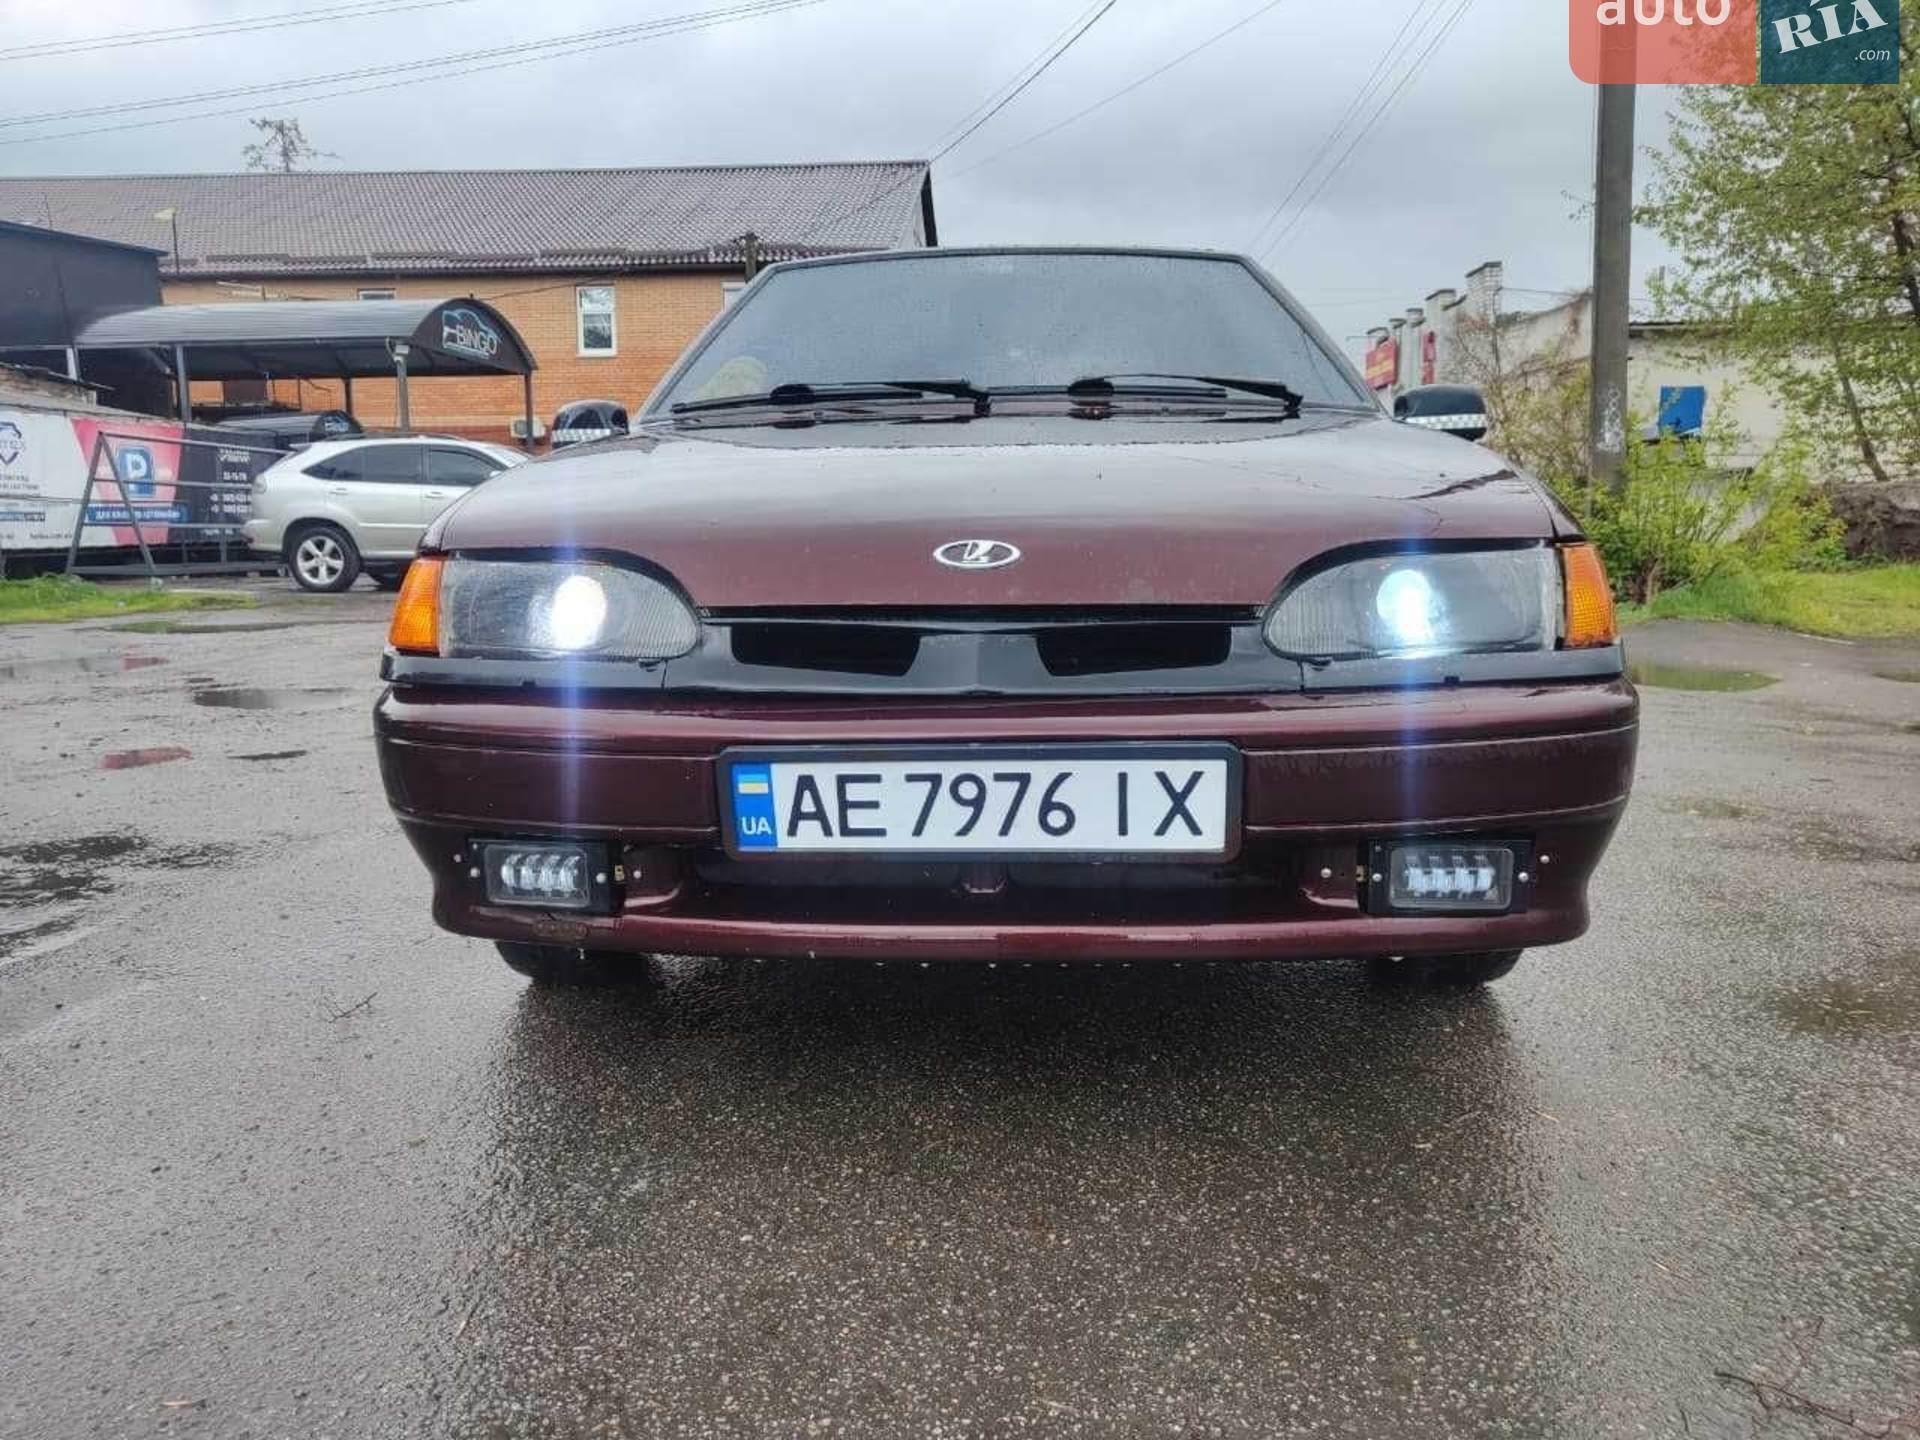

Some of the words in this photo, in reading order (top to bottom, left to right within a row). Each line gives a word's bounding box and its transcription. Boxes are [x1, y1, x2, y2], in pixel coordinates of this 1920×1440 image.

[456, 324, 498, 355] BINGO
[786, 773, 888, 838] AE
[904, 771, 1076, 837] 7976
[741, 818, 772, 835] UA
